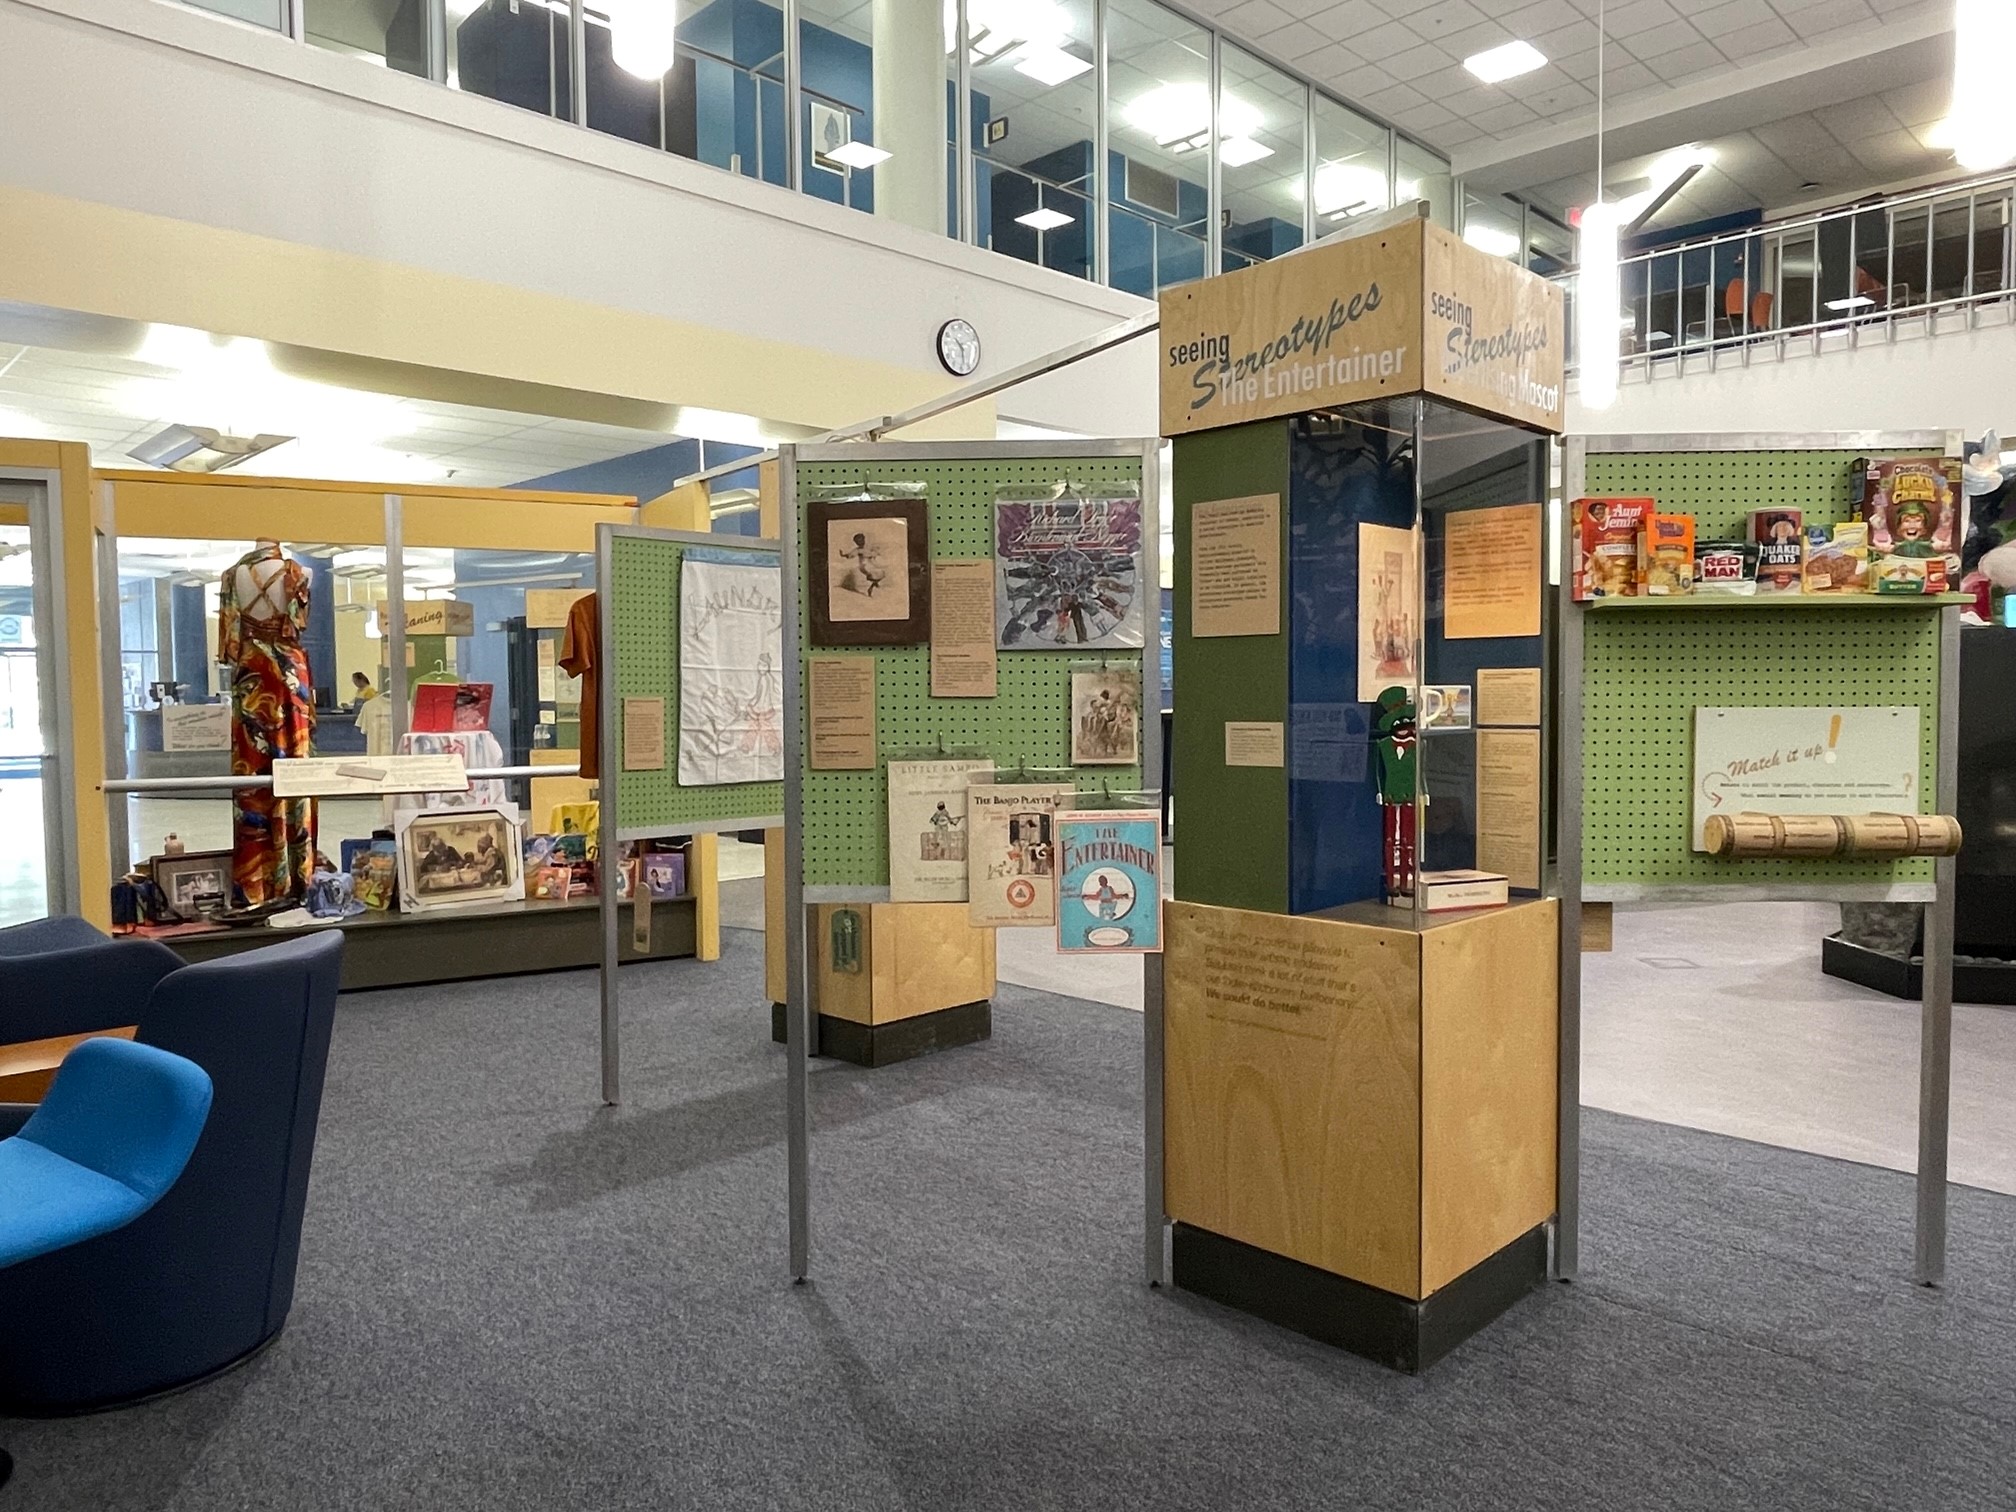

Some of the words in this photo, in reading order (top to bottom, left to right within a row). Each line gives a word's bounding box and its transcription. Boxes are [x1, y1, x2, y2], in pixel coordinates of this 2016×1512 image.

[1431, 291, 1473, 336] seeing
[1169, 332, 1230, 367] seeing
[1191, 282, 1383, 410] Stereotypes
[1445, 323, 1548, 376] Stereotypes
[1219, 366, 1258, 406] The
[1264, 345, 1407, 399] Entertainer
[1518, 367, 1559, 413] Mascot
[1597, 514, 1639, 532] Jemi
[1612, 503, 1643, 517] Aunt
[1704, 555, 1740, 567] RED
[1704, 567, 1740, 578] MAN
[1768, 554, 1797, 564] OATS
[901, 765, 938, 774] LITTLE
[1727, 749, 1781, 777] Match
[1786, 748, 1800, 763] it
[974, 796, 991, 805] THE
[993, 795, 1020, 807] BANJO
[1021, 796, 1052, 804] PLAYER
[1061, 835, 1155, 876] ENTERTAINER
